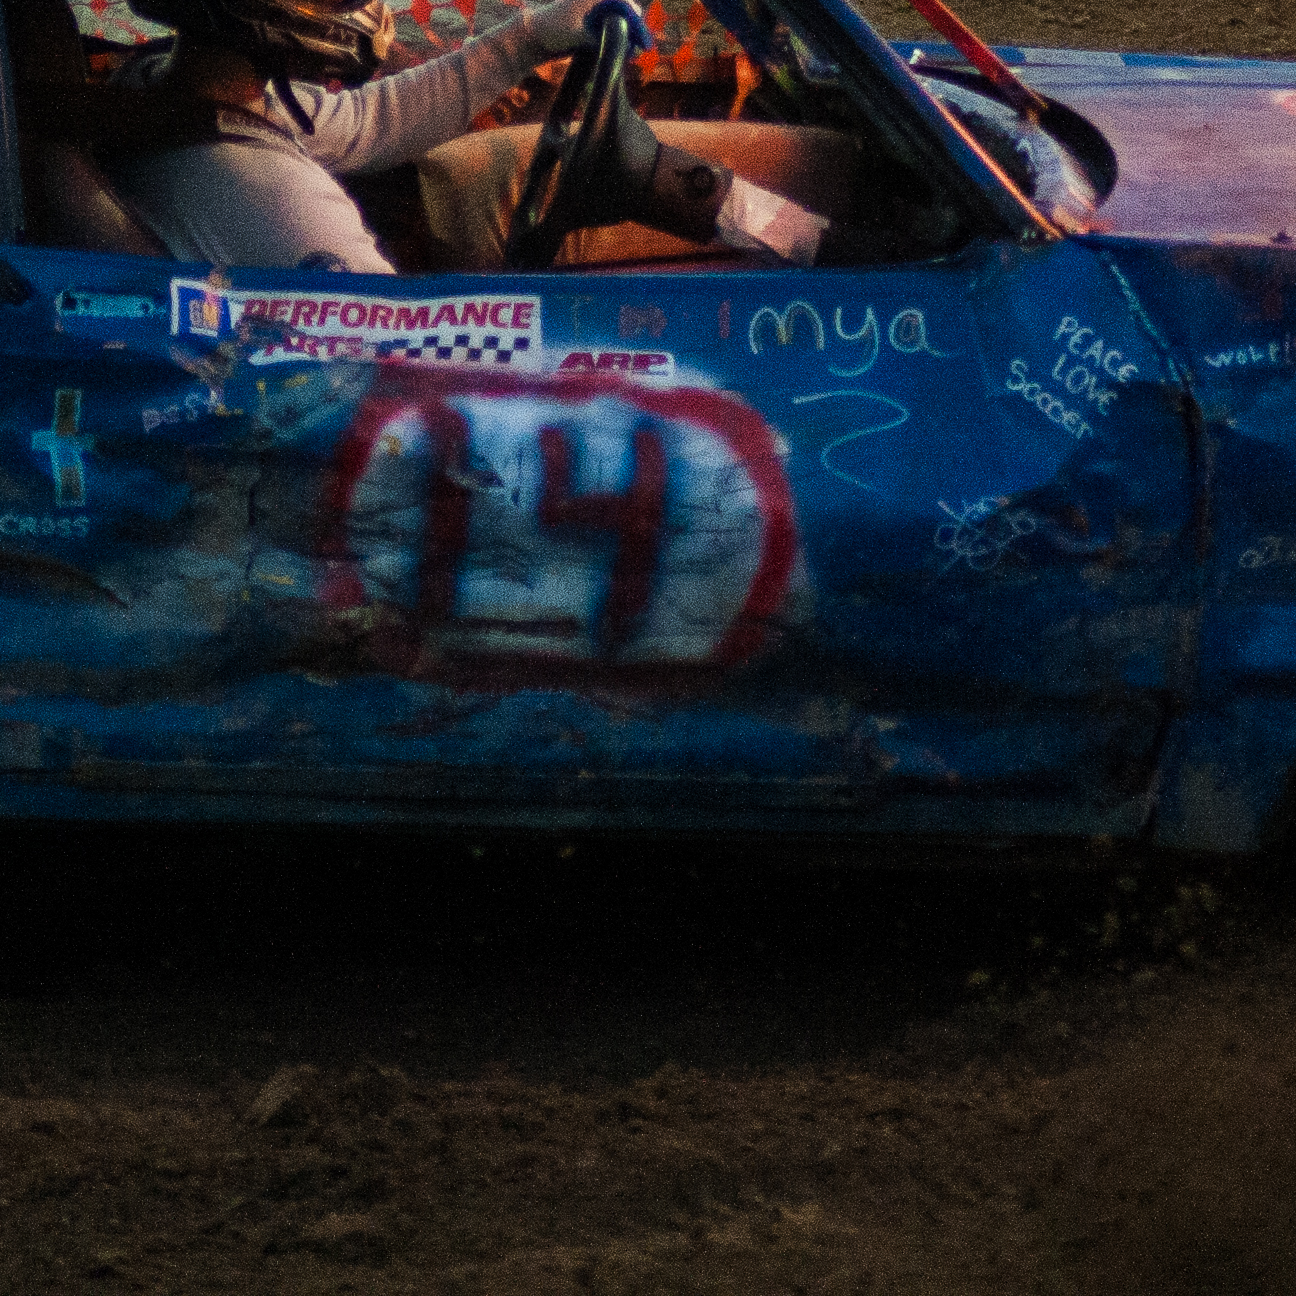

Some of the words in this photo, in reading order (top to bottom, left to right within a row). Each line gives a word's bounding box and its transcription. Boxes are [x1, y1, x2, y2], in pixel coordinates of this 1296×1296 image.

[241, 297, 535, 331] PERFORMANCE
[559, 352, 670, 370] ARP
[416, 404, 666, 662] 14
